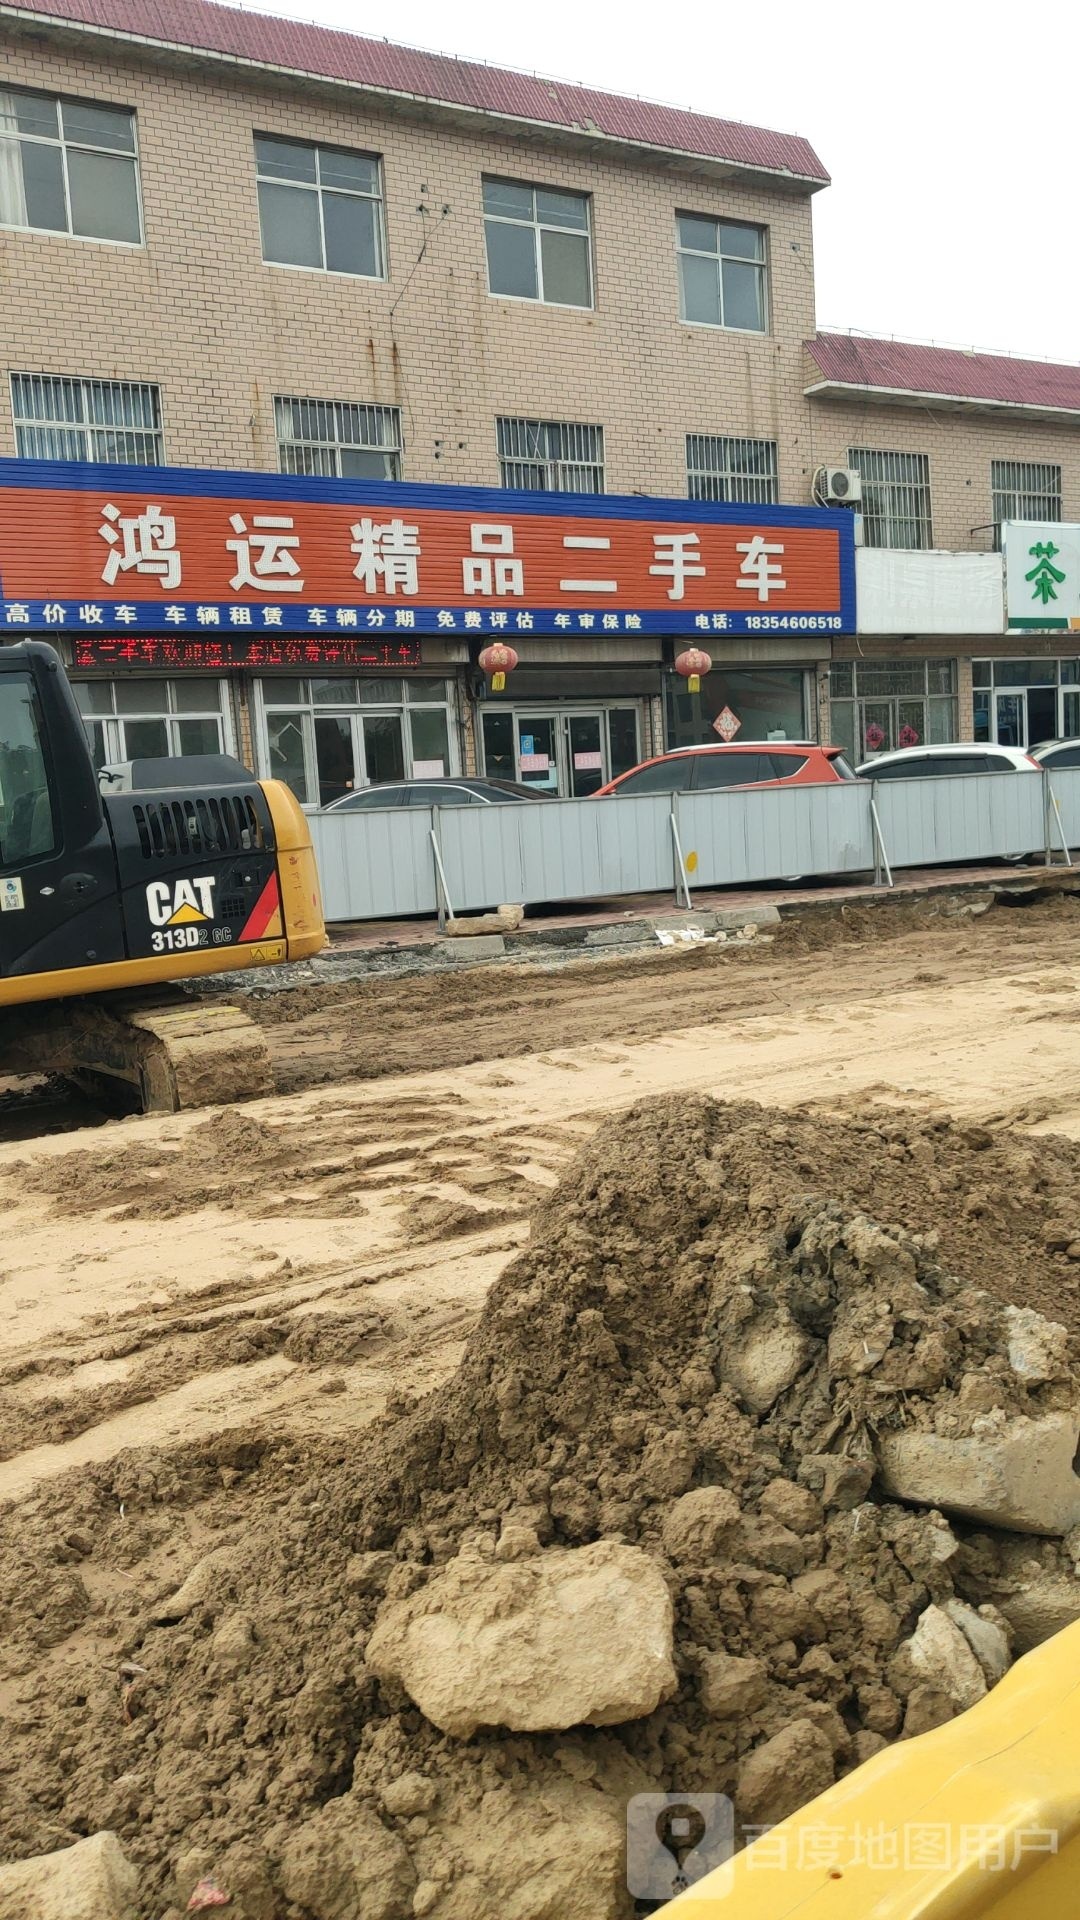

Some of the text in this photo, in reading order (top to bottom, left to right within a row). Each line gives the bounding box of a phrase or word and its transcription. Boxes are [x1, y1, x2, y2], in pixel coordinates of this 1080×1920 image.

[98, 502, 786, 602] 鸿运精品二手车
[1025, 541, 1067, 605] 茶
[4, 602, 138, 625] 高价收车
[164, 604, 284, 627] 车辆租赁
[307, 607, 416, 628] 车辆分期
[436, 608, 535, 629] 免费评估
[554, 611, 642, 630] 年审保险
[745, 615, 842, 630] 18354606518
[146, 876, 215, 926] CAT
